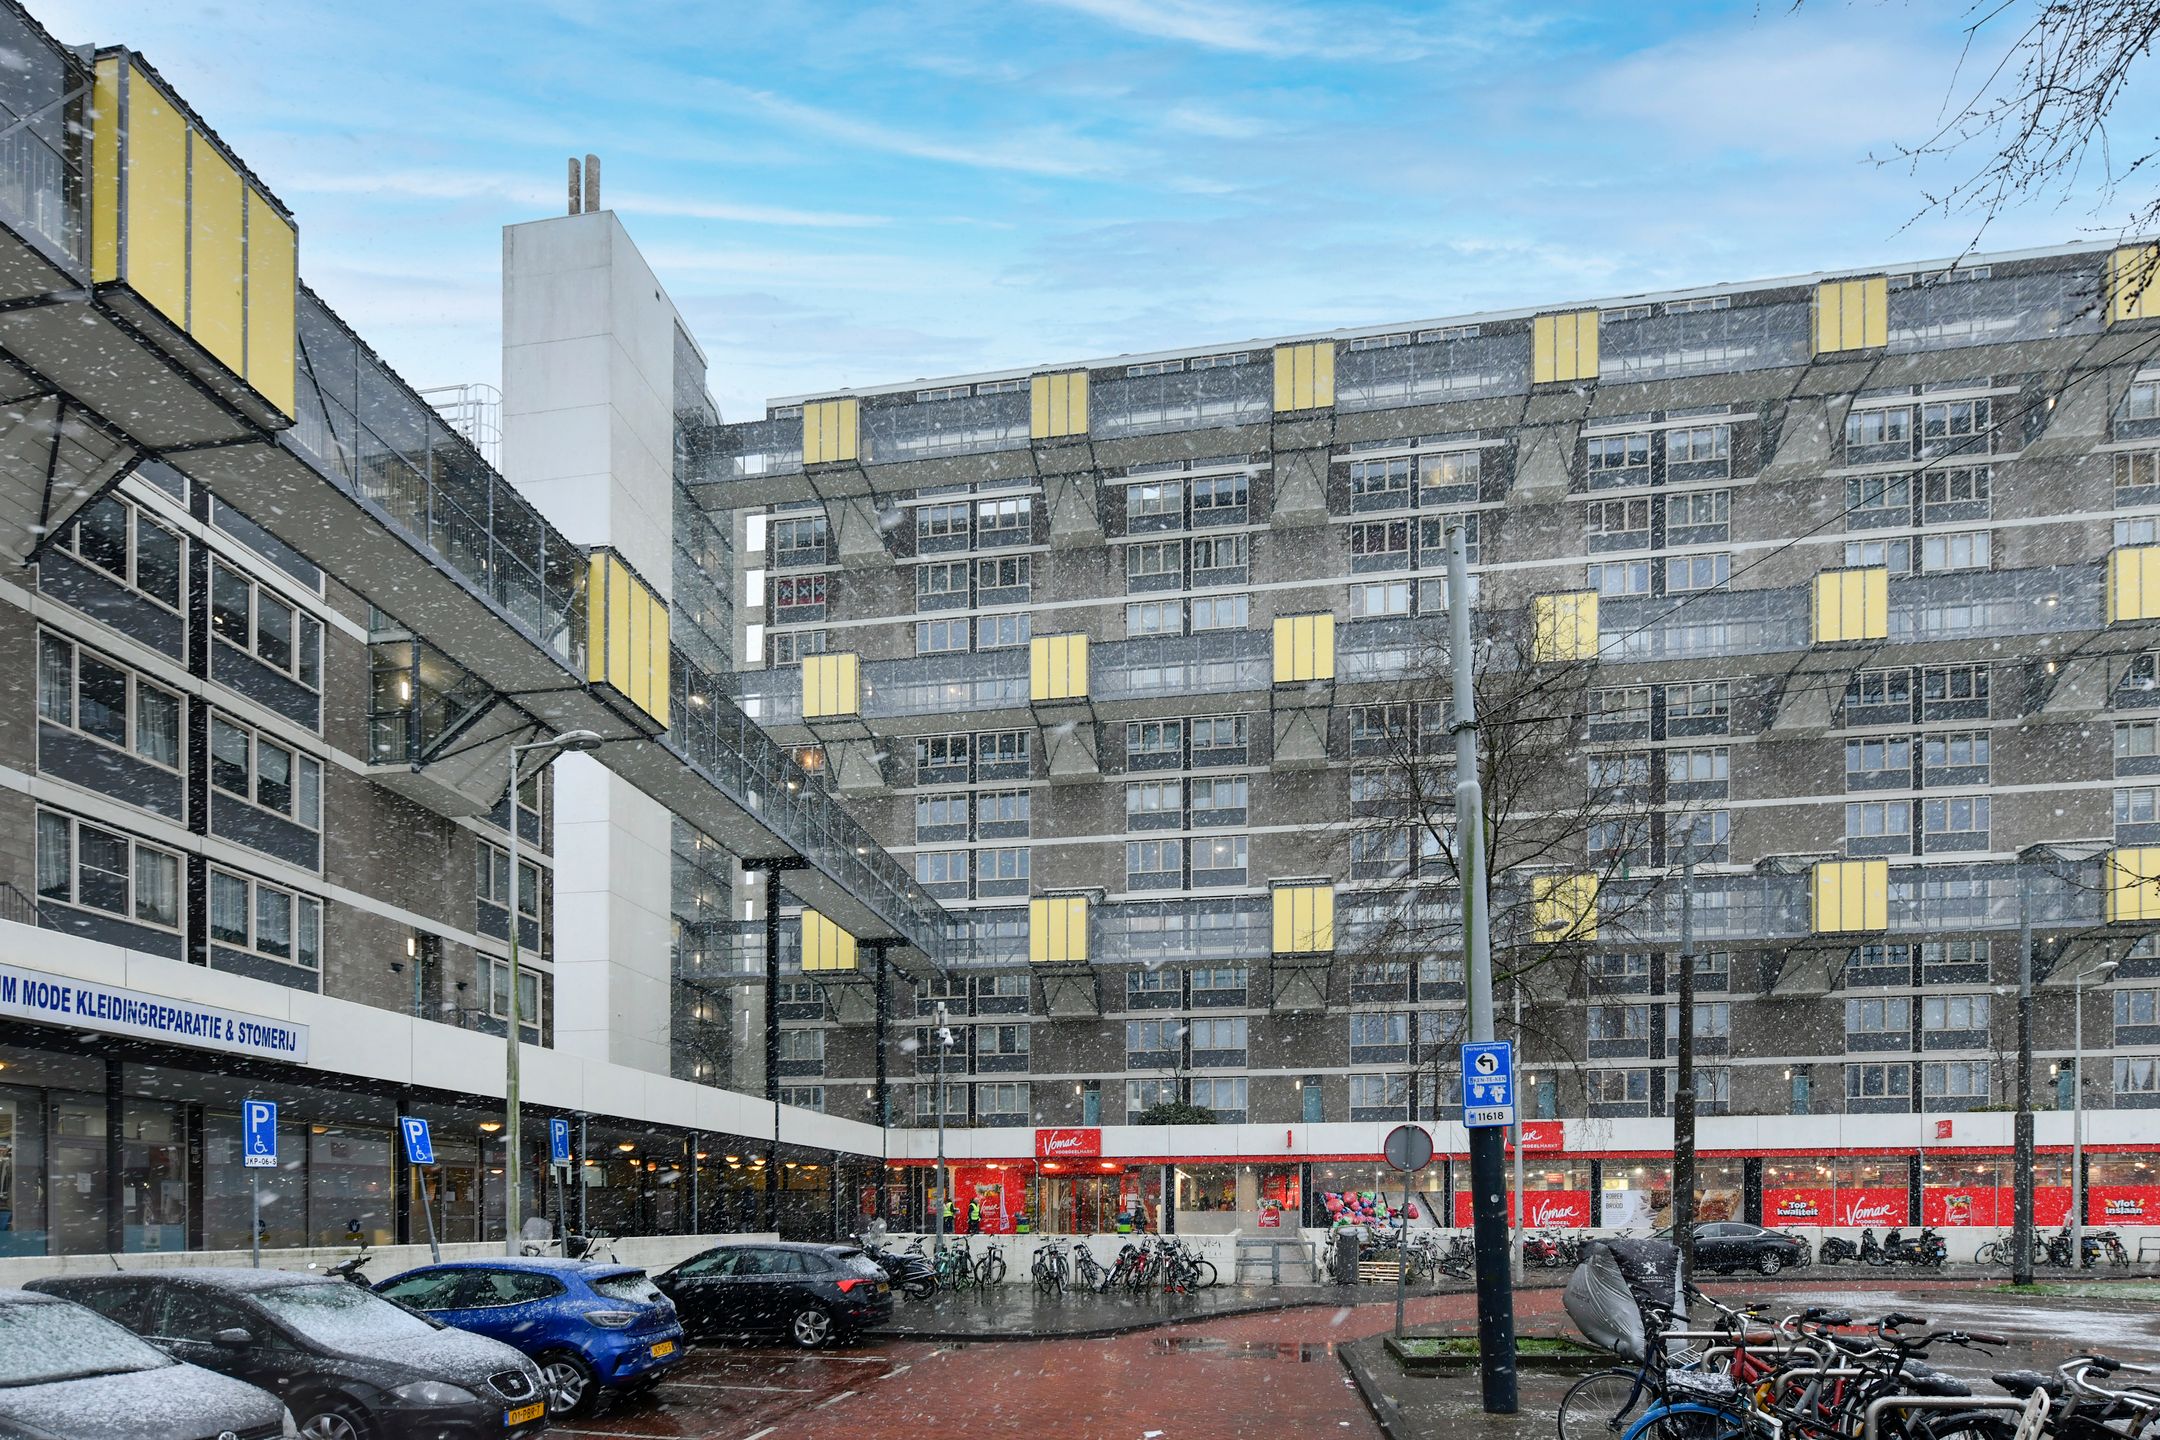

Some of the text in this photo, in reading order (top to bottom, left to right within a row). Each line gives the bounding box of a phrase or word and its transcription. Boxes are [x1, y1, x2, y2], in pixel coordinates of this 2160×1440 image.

[0, 975, 296, 1051] M MODE KLEIDINGREPARATIE & STOMERIJ
[252, 1105, 269, 1133] P
[1478, 1111, 1504, 1120] 11618
[408, 1121, 423, 1143] P
[555, 1122, 565, 1143] P
[1044, 1131, 1082, 1156] Vomar
[1532, 1199, 1579, 1227] Vomar
[1777, 1208, 1818, 1216] kwaliteit
[1788, 1202, 1807, 1210] Top
[1846, 1197, 1897, 1225] Vomar
[2105, 1206, 2142, 1214] inslaan
